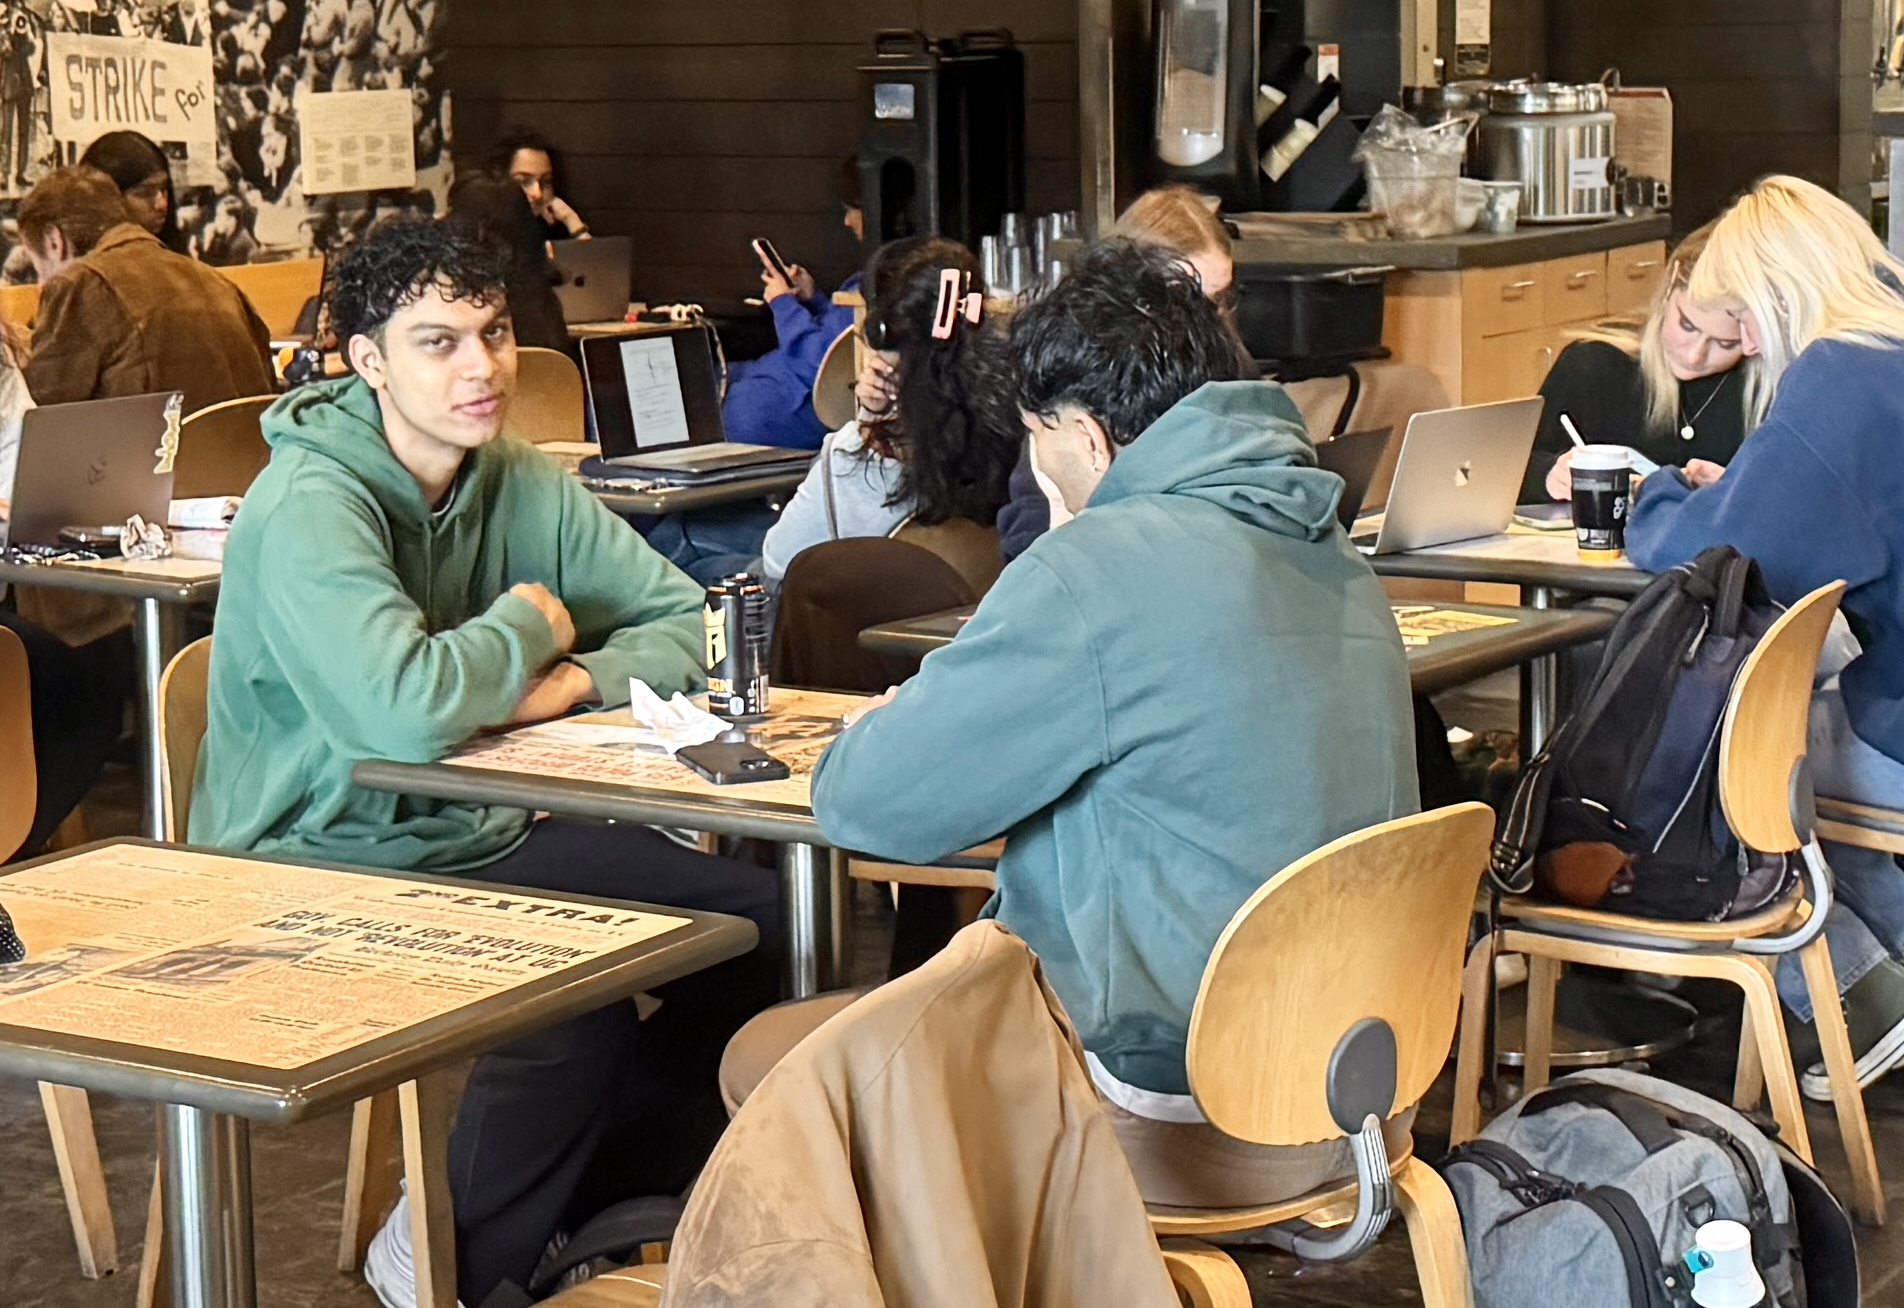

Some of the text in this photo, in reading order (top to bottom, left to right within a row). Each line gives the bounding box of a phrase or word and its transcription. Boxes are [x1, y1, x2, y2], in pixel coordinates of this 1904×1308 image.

[66, 52, 167, 123] STRIKE
[338, 918, 411, 932] CALLS
[411, 927, 462, 940] FOR
[452, 896, 640, 927] EXTRA!
[253, 919, 307, 931] AND
[305, 925, 358, 938] NOT
[489, 953, 531, 964] AT
